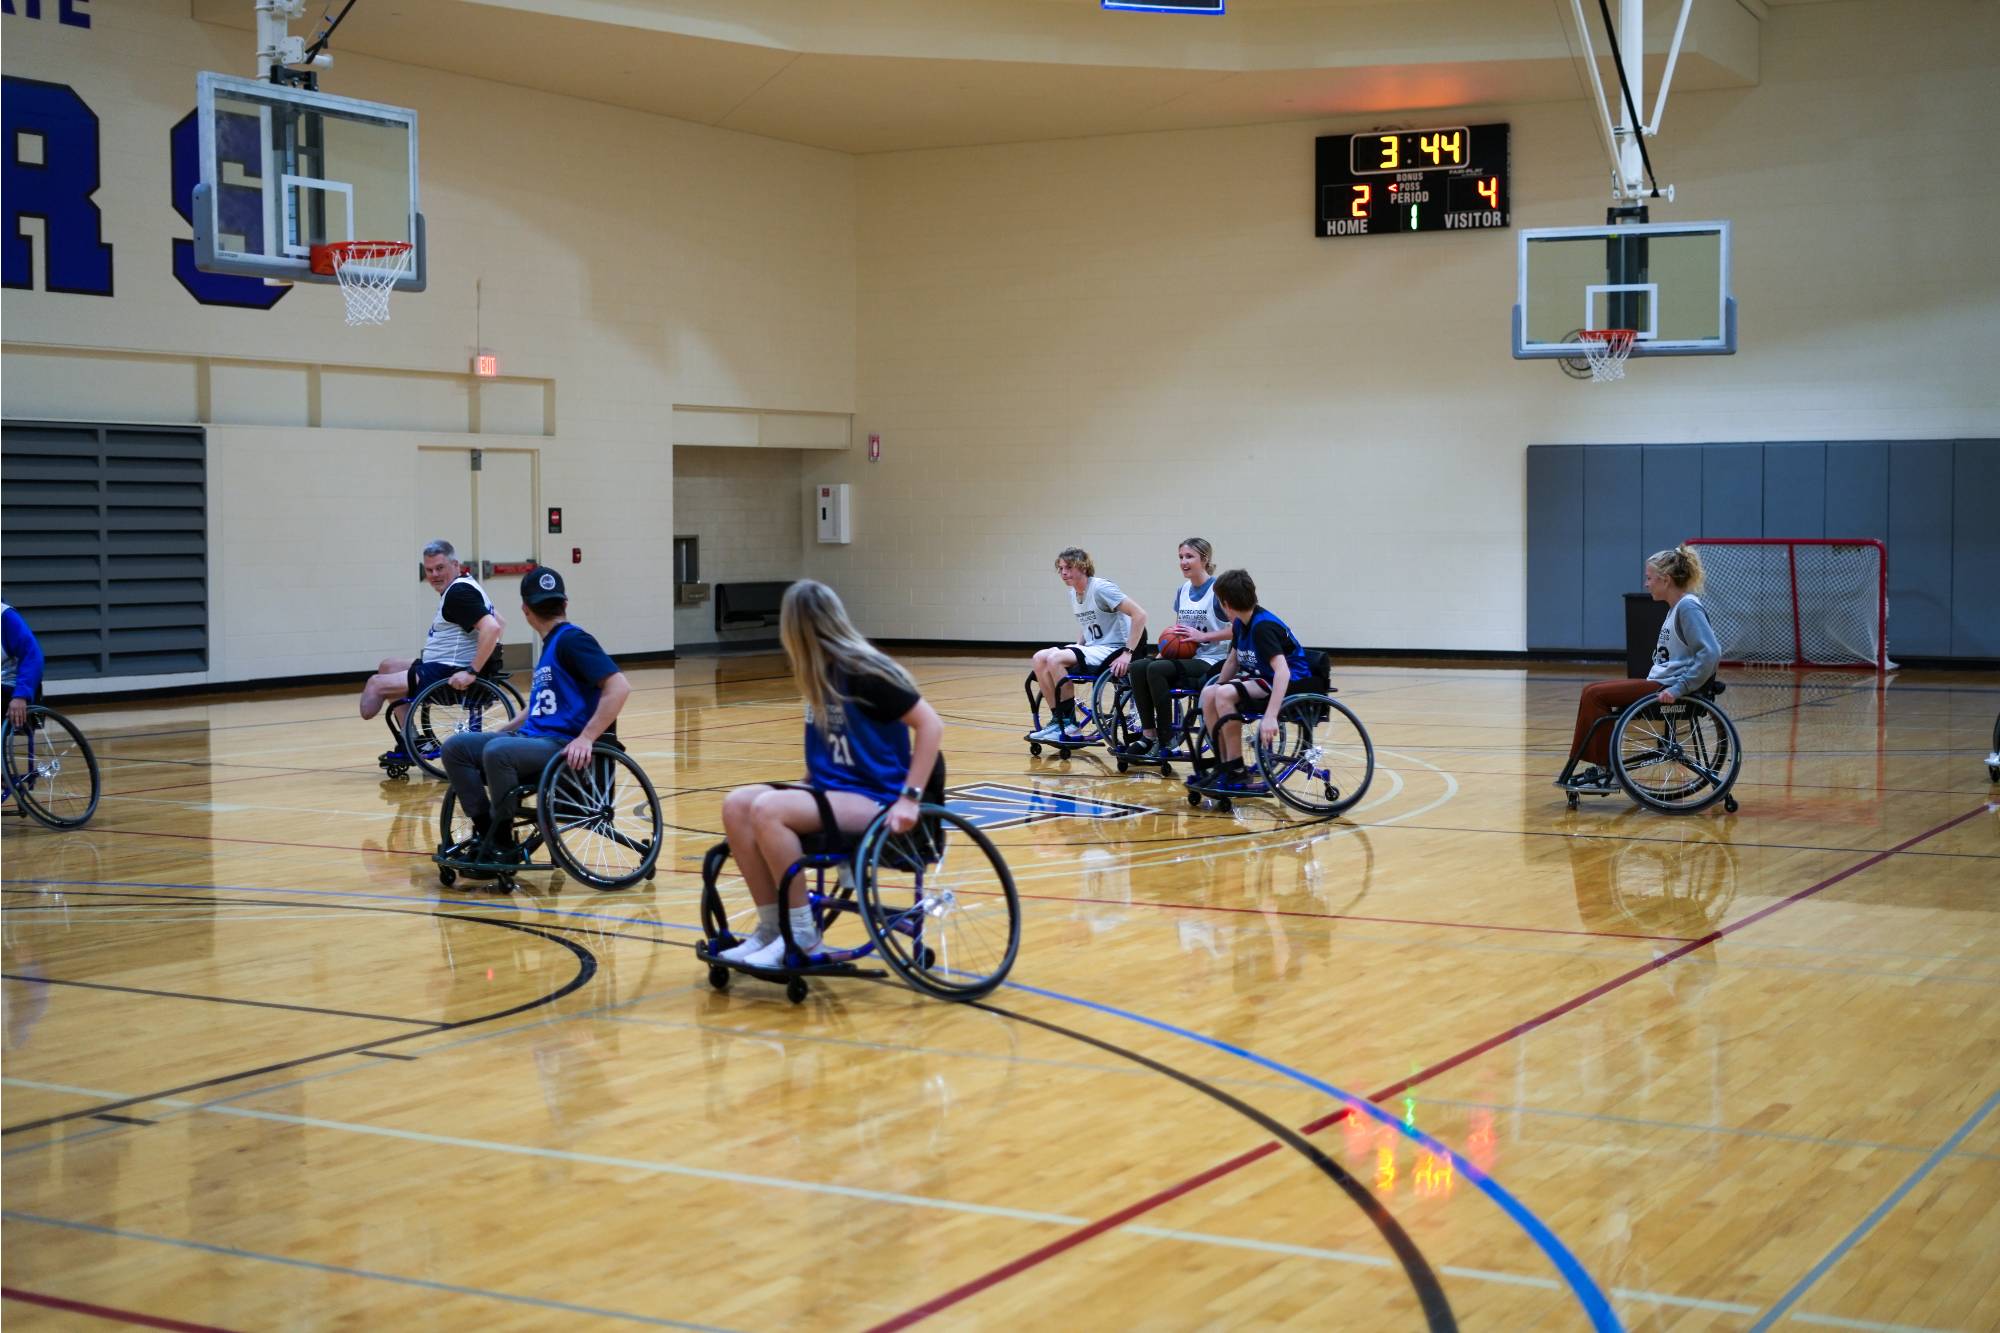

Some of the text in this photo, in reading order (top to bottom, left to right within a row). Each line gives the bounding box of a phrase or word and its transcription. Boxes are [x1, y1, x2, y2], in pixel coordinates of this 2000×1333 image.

[1396, 172, 1424, 182] BONUS
[1400, 182, 1421, 191] POSS
[1478, 176, 1497, 209] 4
[1352, 185, 1370, 217] 2
[1390, 190, 1429, 204] PERIOD
[1410, 204, 1418, 230] 1
[1444, 211, 1502, 229] VISITOR
[1327, 219, 1368, 236] HOME
[1088, 623, 1104, 641] 10
[531, 689, 558, 716] 23
[829, 734, 855, 766] 21
